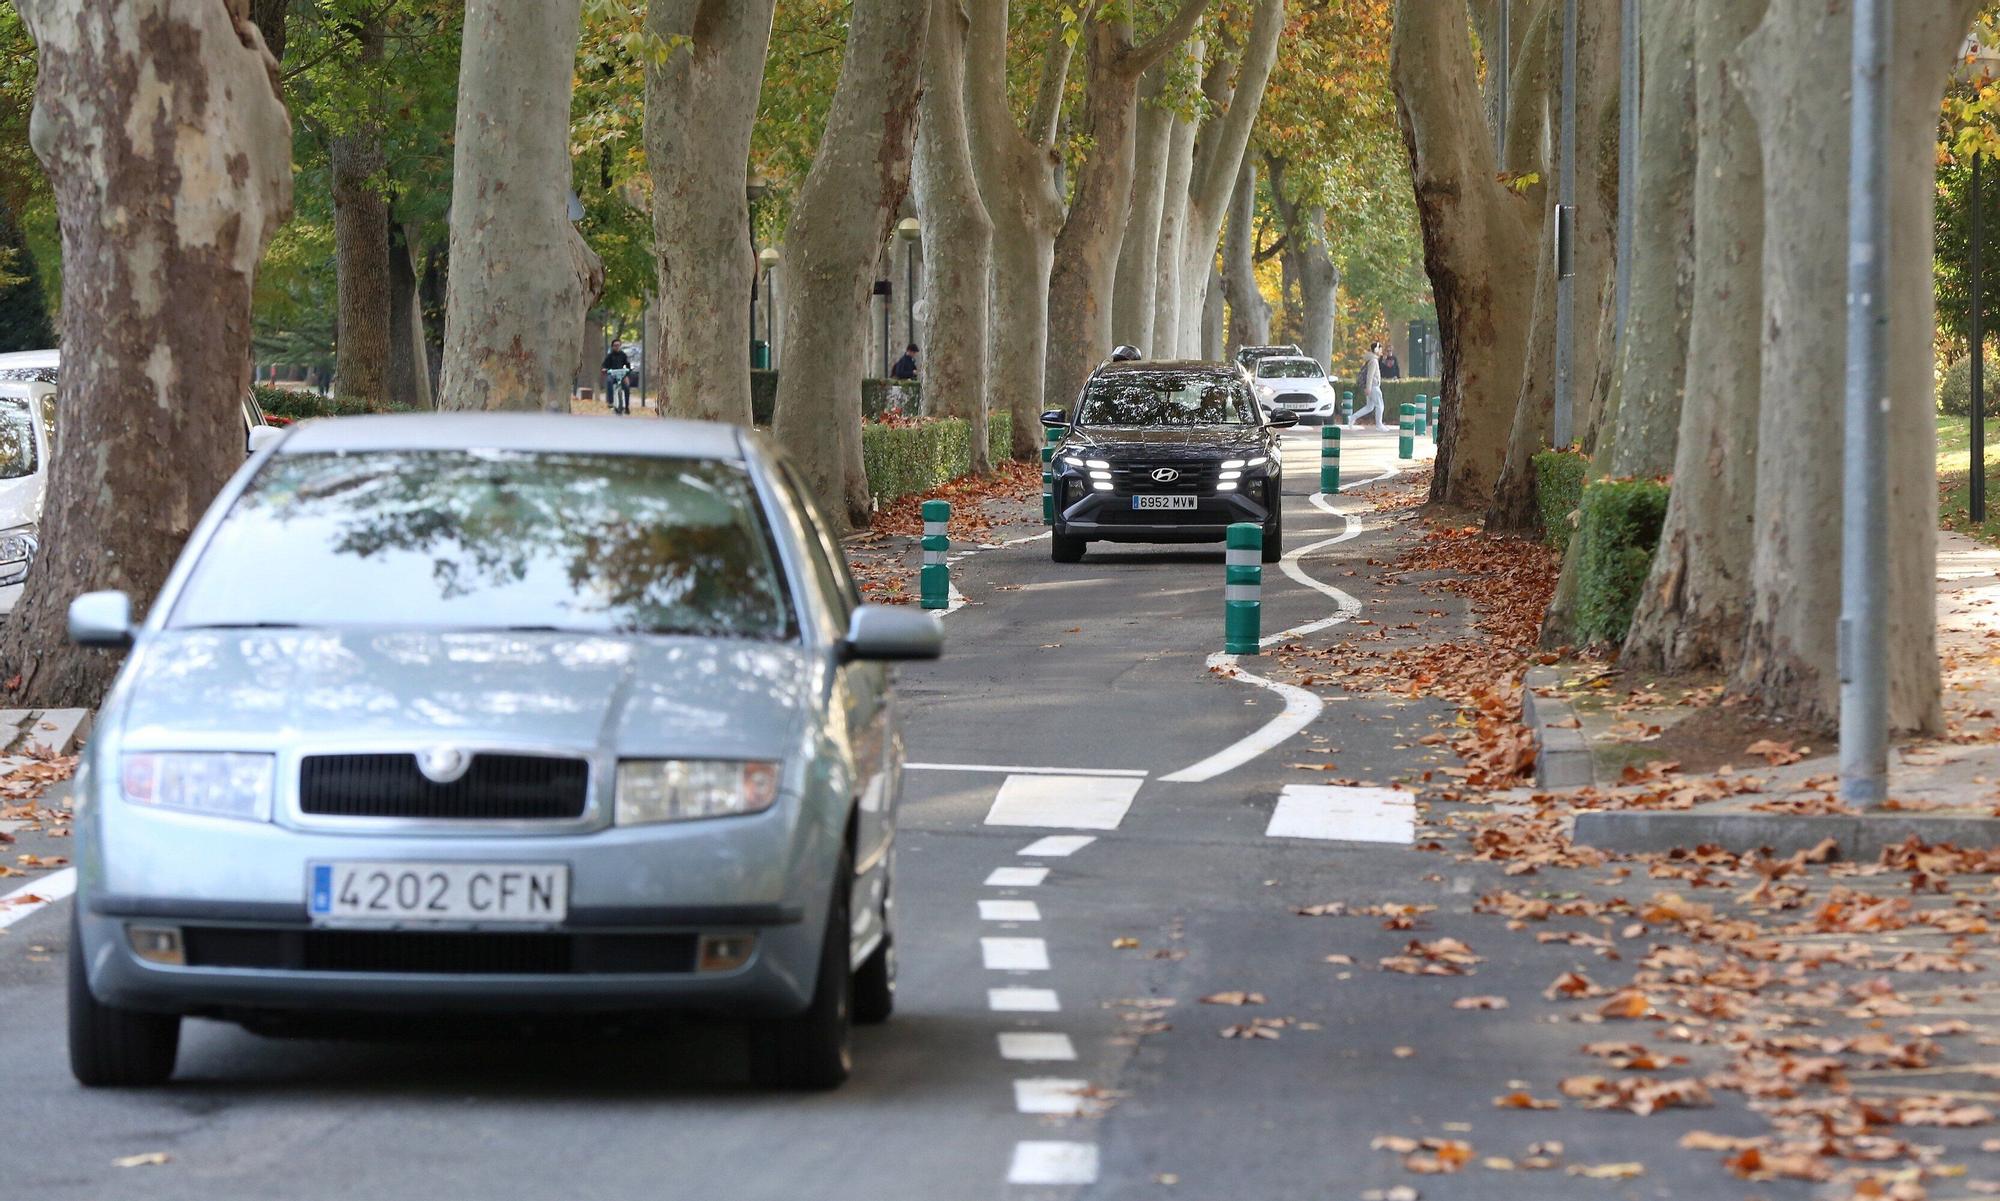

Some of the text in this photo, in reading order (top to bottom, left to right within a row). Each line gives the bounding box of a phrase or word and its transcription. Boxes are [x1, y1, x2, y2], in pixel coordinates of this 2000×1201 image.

[1141, 497, 1170, 508] 6952
[1173, 497, 1194, 508] MVW
[338, 872, 450, 910] 4202
[468, 872, 554, 911] CFN
